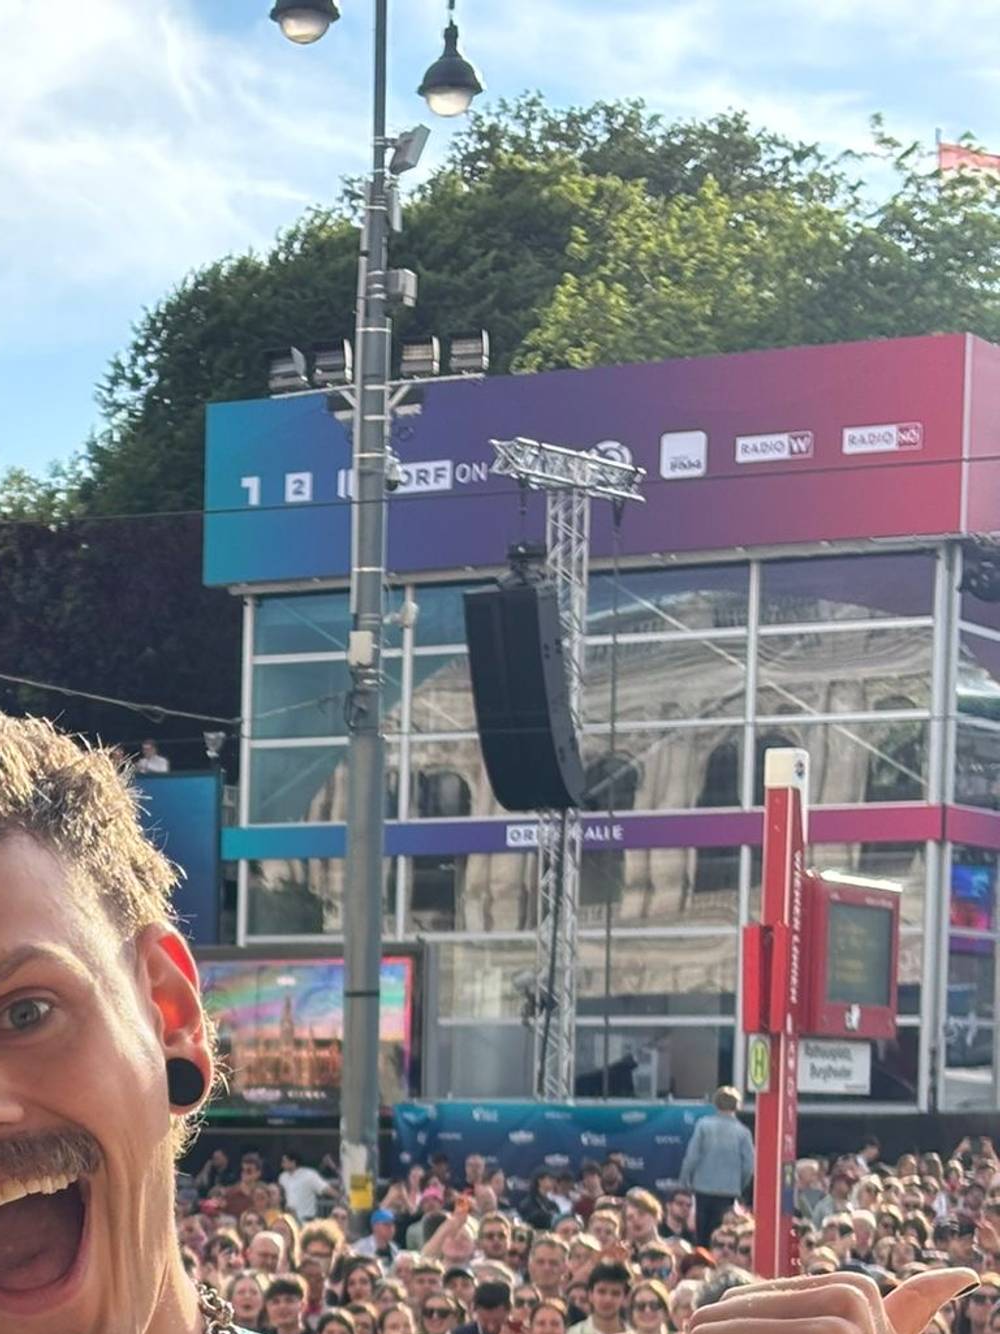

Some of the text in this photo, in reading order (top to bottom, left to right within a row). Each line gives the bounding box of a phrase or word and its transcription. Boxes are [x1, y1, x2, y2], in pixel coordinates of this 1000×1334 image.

[847, 430, 893, 447] RADIO
[741, 440, 786, 456] RADIO
[455, 460, 488, 484] ON
[291, 479, 306, 496] 2
